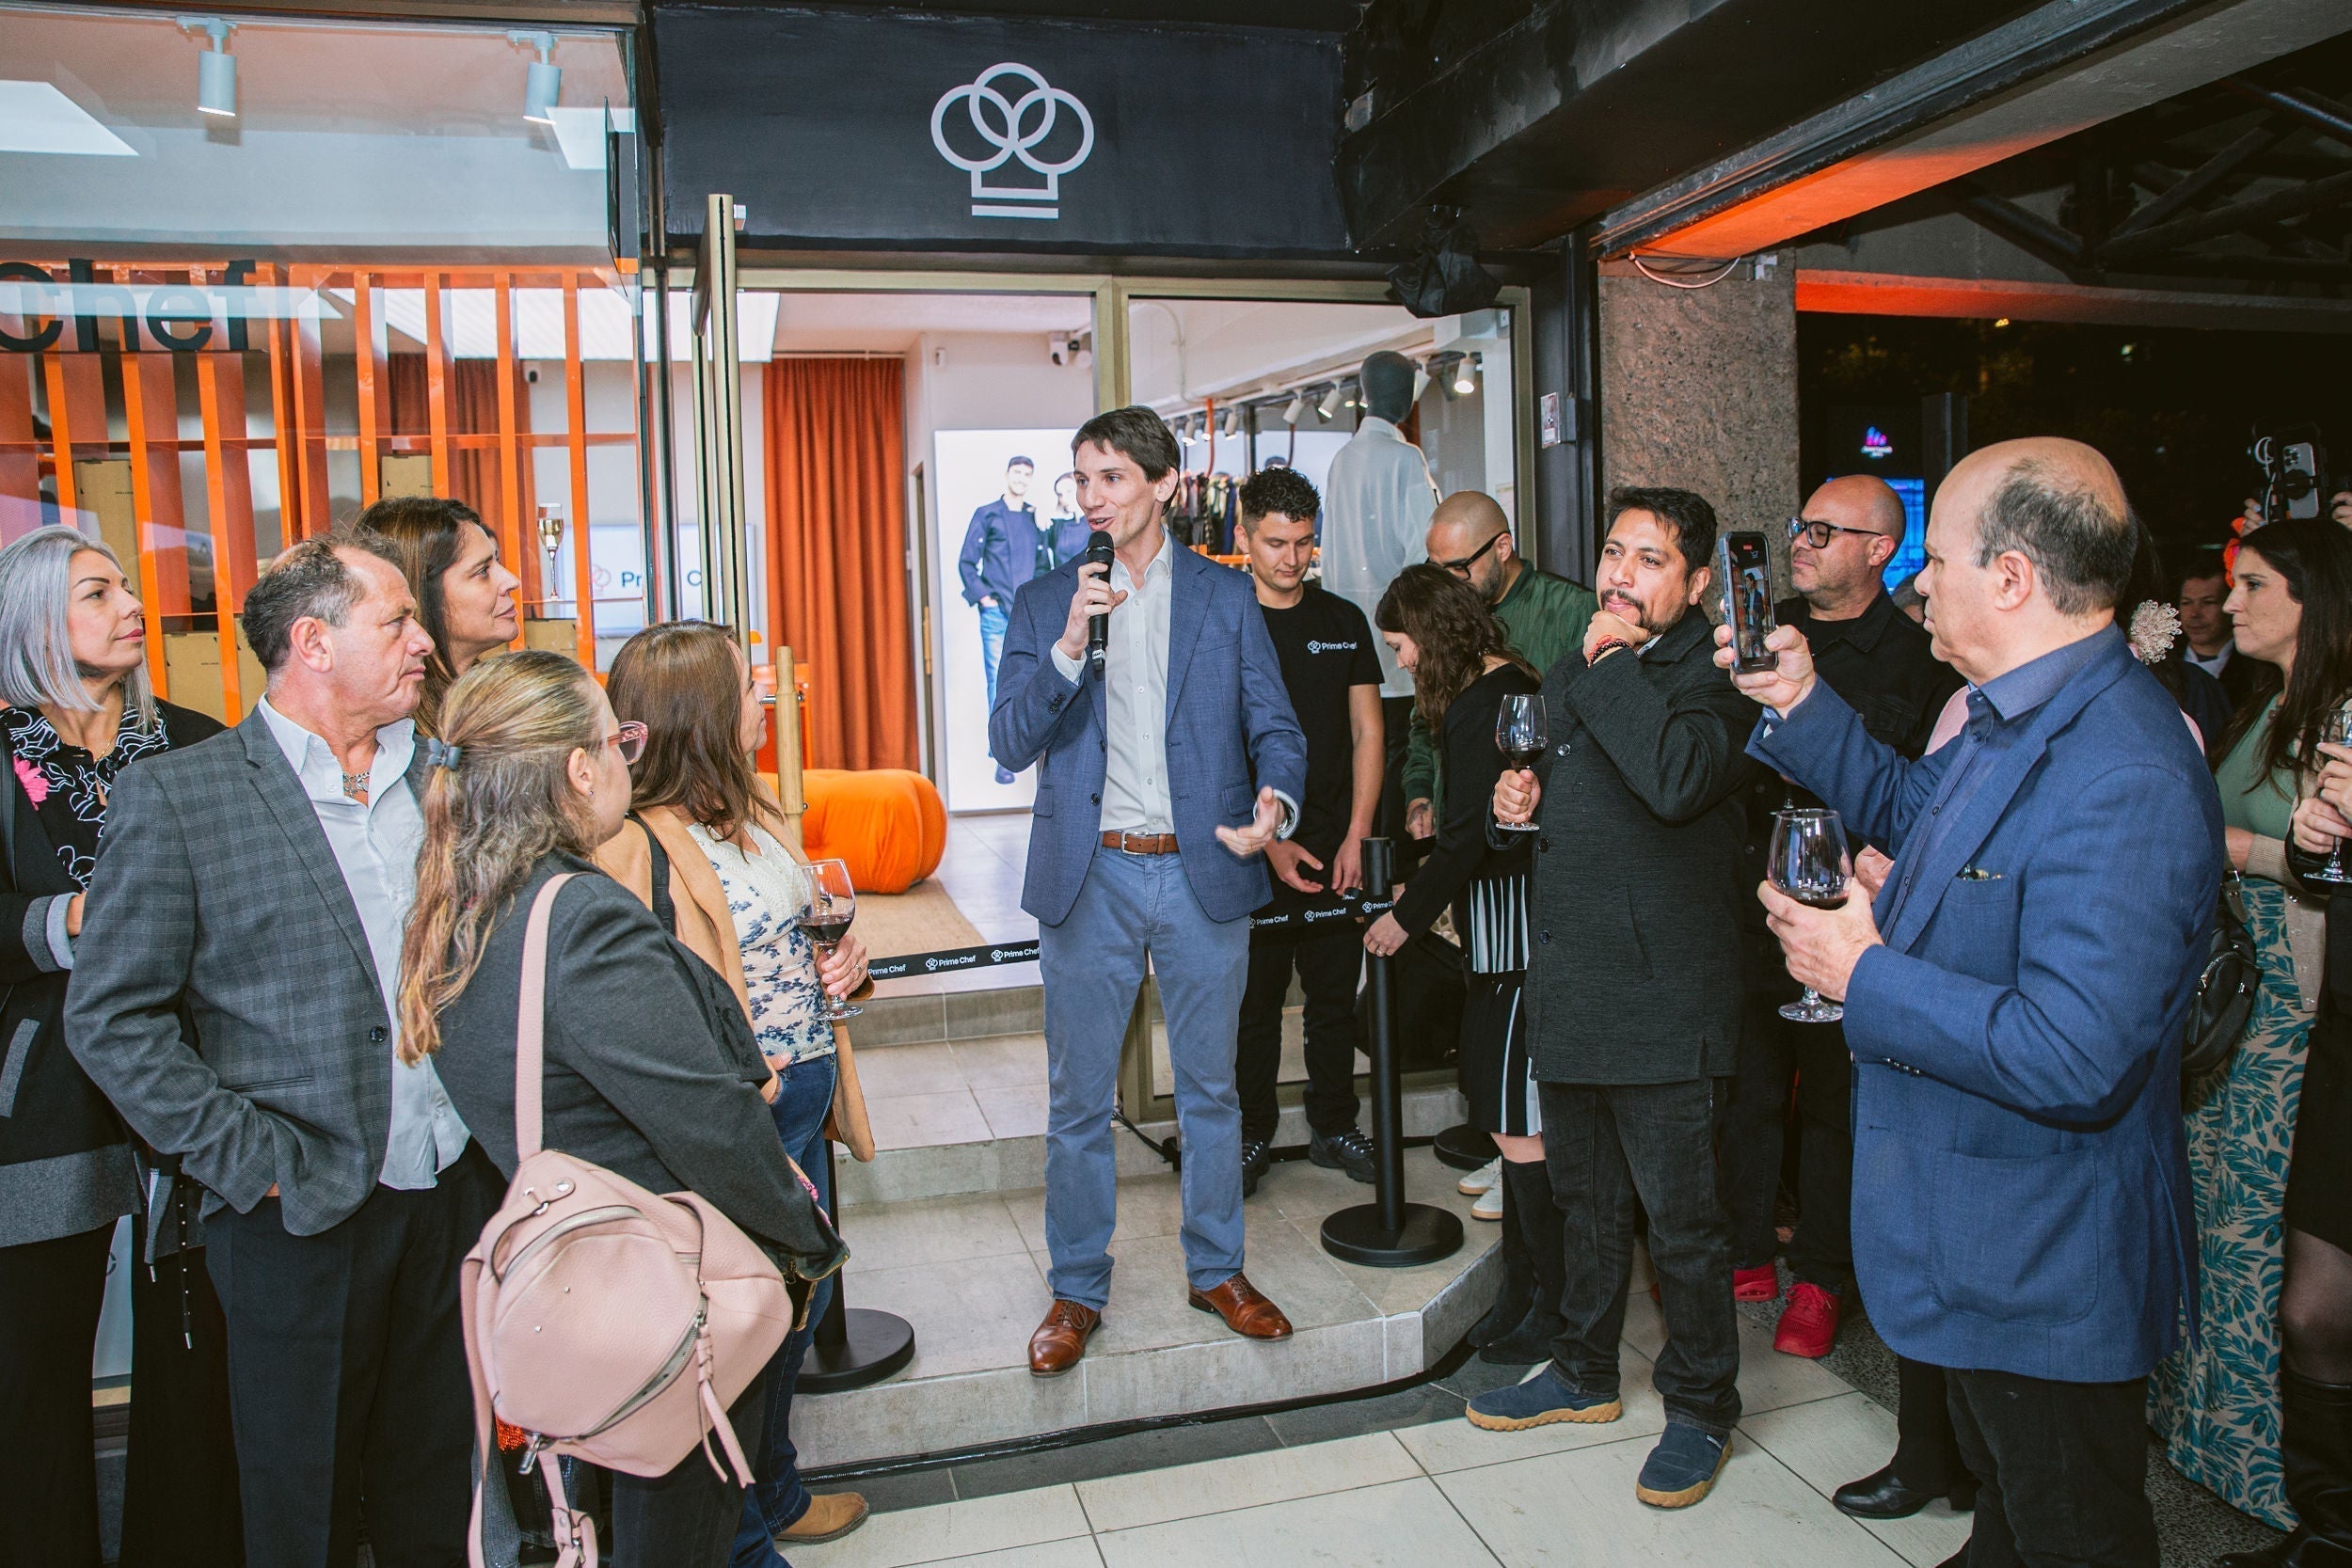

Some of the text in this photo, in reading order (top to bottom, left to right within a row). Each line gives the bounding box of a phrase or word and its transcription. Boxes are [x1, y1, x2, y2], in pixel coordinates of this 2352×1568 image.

[0, 258, 256, 352] Chef
[1321, 641, 1343, 650] Prime
[1332, 907, 1346, 915] Chef
[1274, 914, 1289, 923] Chef
[1004, 950, 1023, 958] Prime
[939, 955, 977, 967] Prime Chef
[867, 963, 906, 975] Prime Chef
